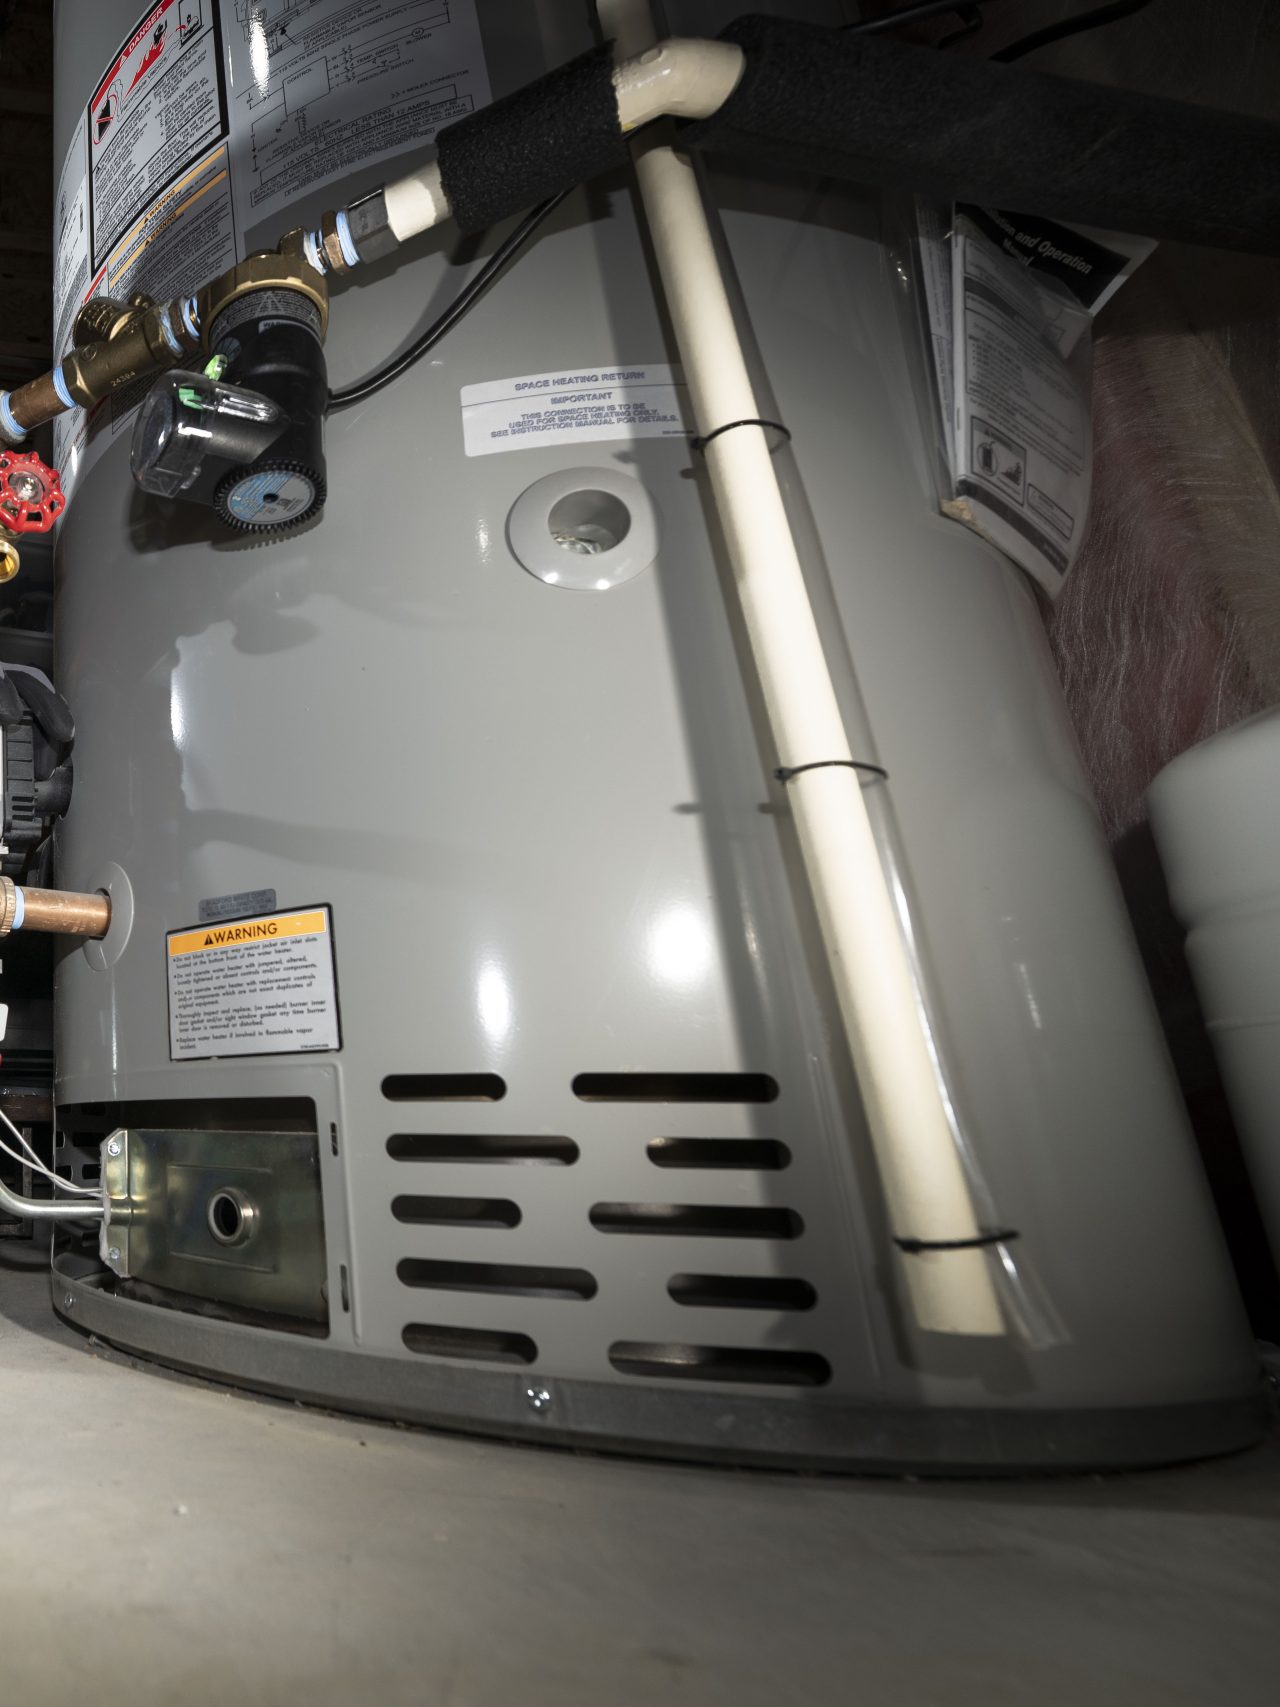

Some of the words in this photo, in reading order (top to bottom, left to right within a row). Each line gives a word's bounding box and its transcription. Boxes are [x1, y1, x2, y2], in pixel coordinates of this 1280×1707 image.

[128, 7, 163, 53] DANGER
[149, 189, 176, 217] WARNING
[151, 212, 177, 240] WARNING
[1015, 232, 1041, 248] and
[1038, 240, 1093, 274] Operation
[515, 379, 550, 391] SPACE
[552, 374, 599, 386] HEATING
[602, 371, 646, 382] RETURN
[551, 392, 613, 405] IMPORTANT
[509, 419, 535, 429] USED
[536, 417, 556, 426] FOR
[558, 412, 589, 423] SPACE
[591, 409, 631, 419] HEATING
[633, 409, 659, 417] ONLY.
[521, 412, 542, 421] THIS
[545, 404, 605, 418] CONNECTION
[619, 403, 631, 411] TO
[633, 402, 646, 410] BE
[491, 430, 509, 438] SEE
[512, 421, 574, 435] INSTRUCTION
[575, 418, 615, 428] MANUAL
[617, 416, 637, 424] FOR
[639, 414, 679, 424] DETAILS.
[214, 923, 277, 943] WARNING
